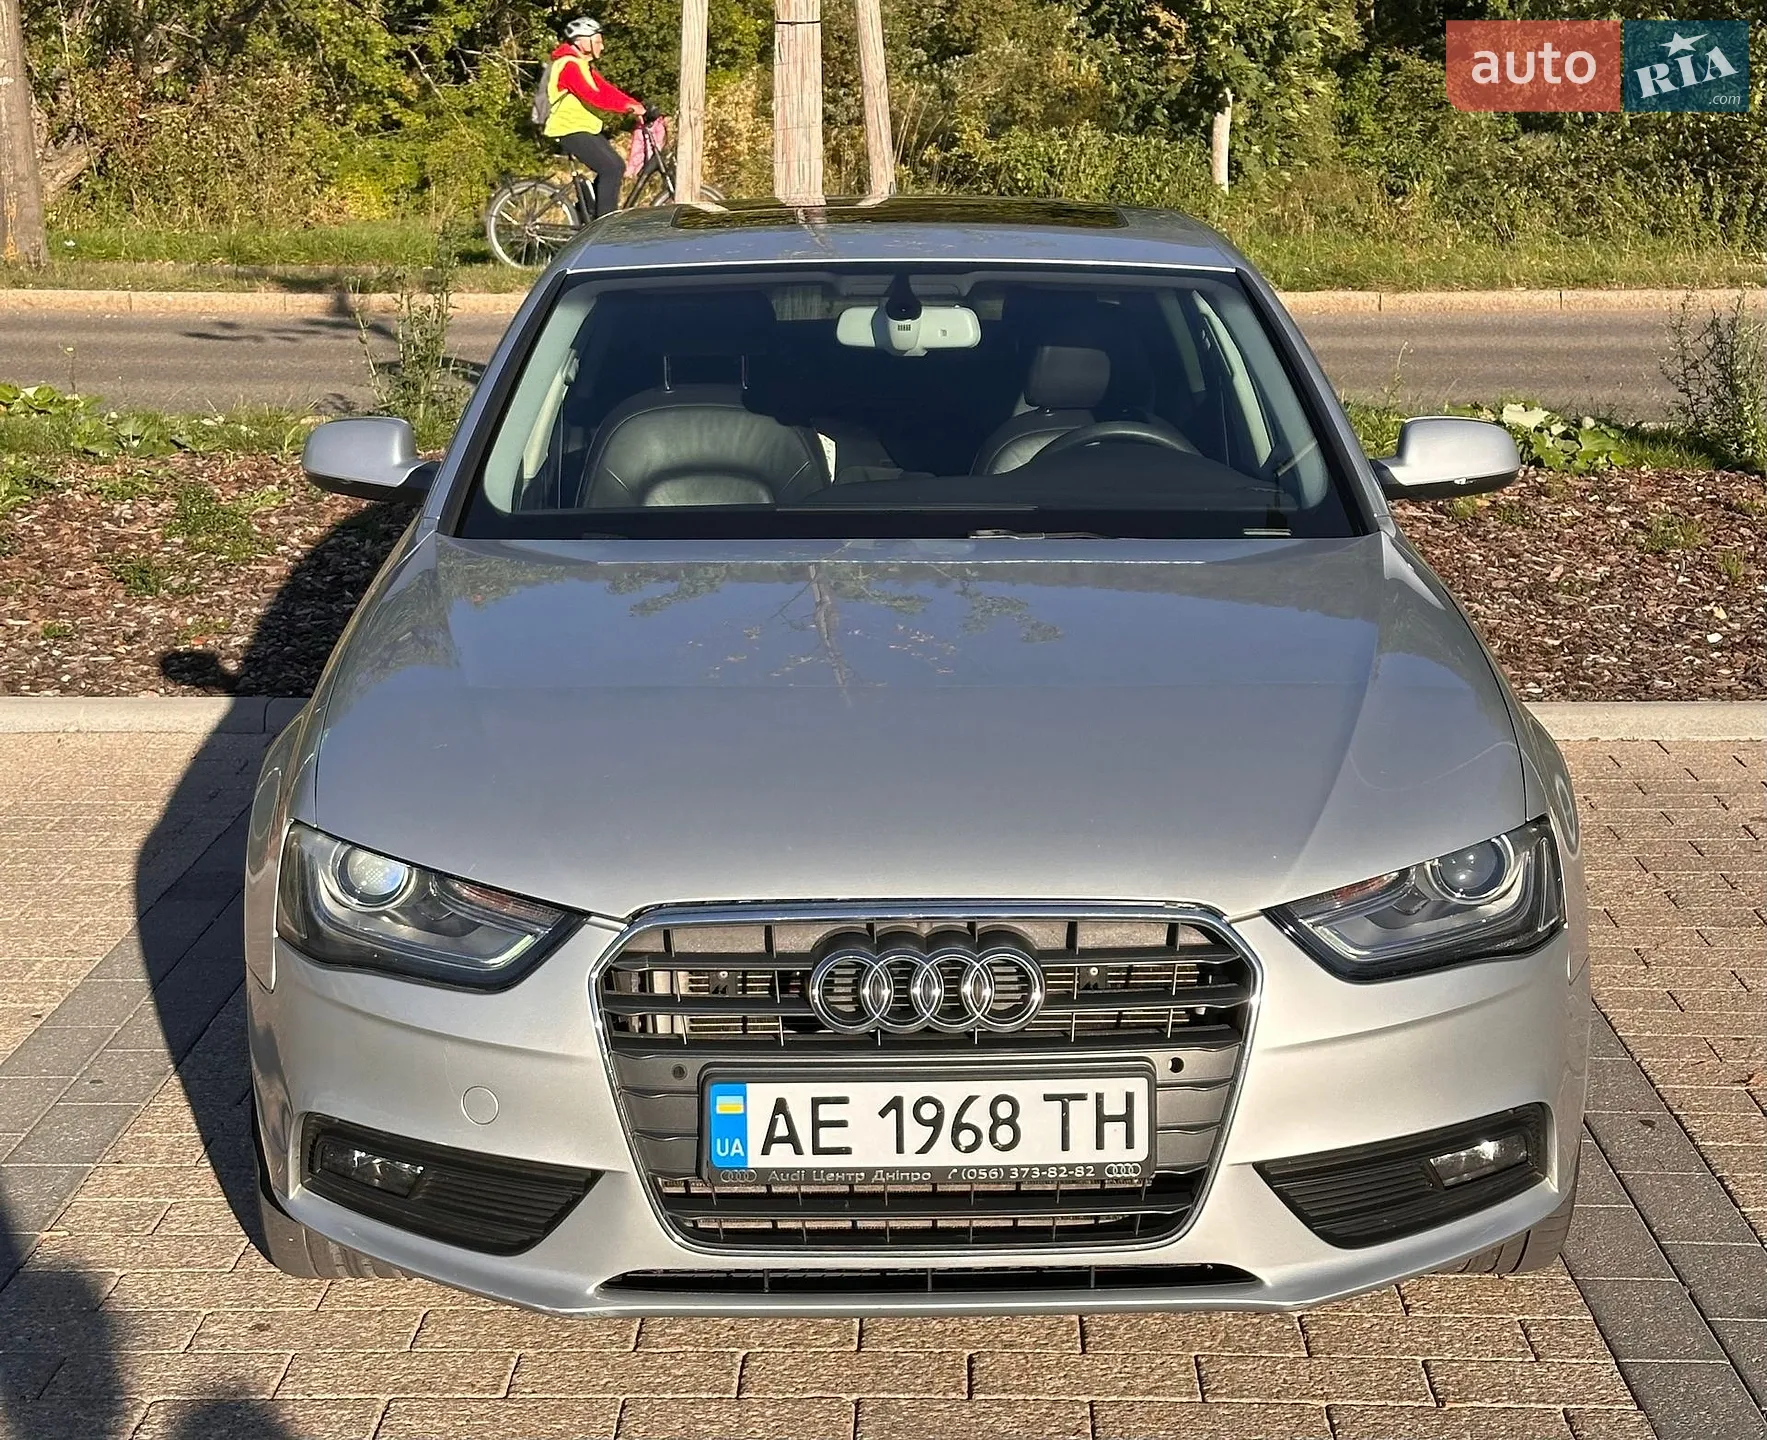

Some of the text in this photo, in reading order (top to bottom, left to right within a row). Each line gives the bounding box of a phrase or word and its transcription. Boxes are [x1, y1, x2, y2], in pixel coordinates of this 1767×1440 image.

[760, 1091, 1135, 1155] AE 1968 TH
[716, 1138, 745, 1157] UA
[767, 1165, 1096, 1184] Audi Центр Дніпро (056) 373-82-82
